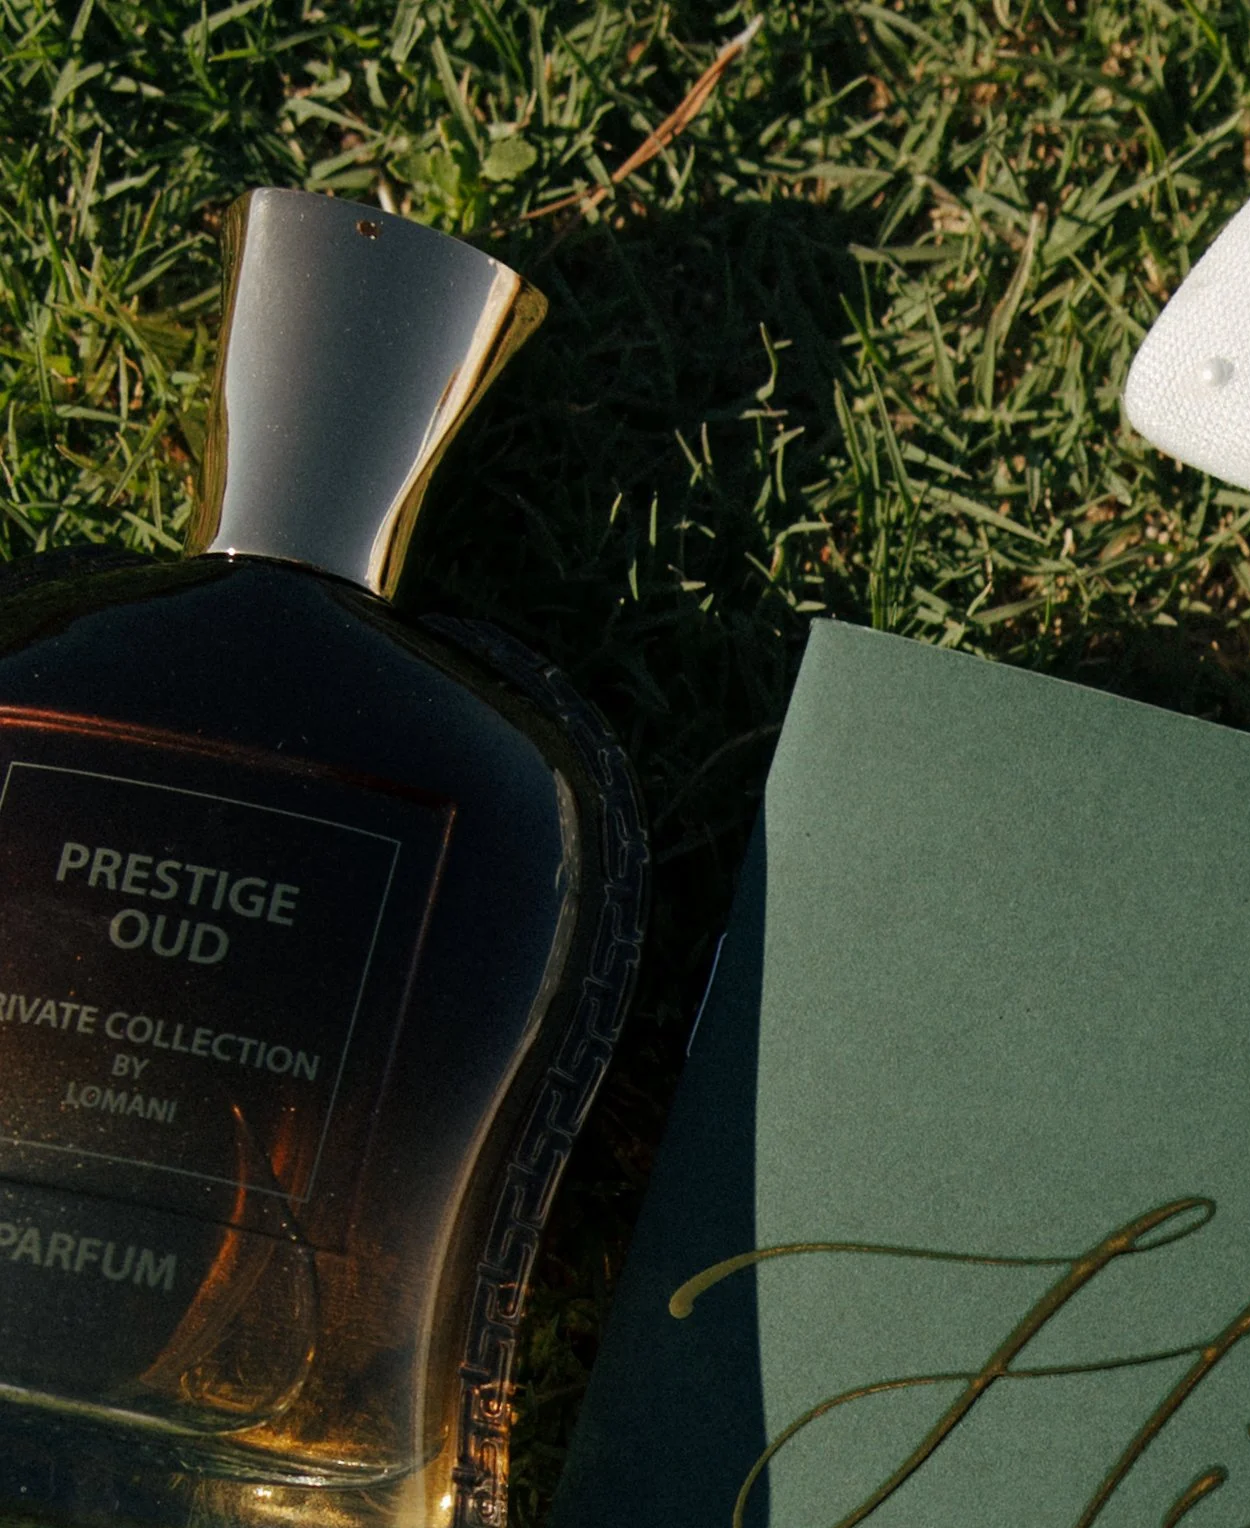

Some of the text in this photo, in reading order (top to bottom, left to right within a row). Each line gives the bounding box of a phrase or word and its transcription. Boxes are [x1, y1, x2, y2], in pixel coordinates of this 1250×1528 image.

[56, 842, 300, 926] PRESTIGE
[109, 909, 229, 965] OUD
[105, 1011, 320, 1081] COLLECTION
[111, 1053, 149, 1079] BY
[64, 1081, 177, 1124] LOMANI
[0, 1222, 177, 1291] PARFUM
